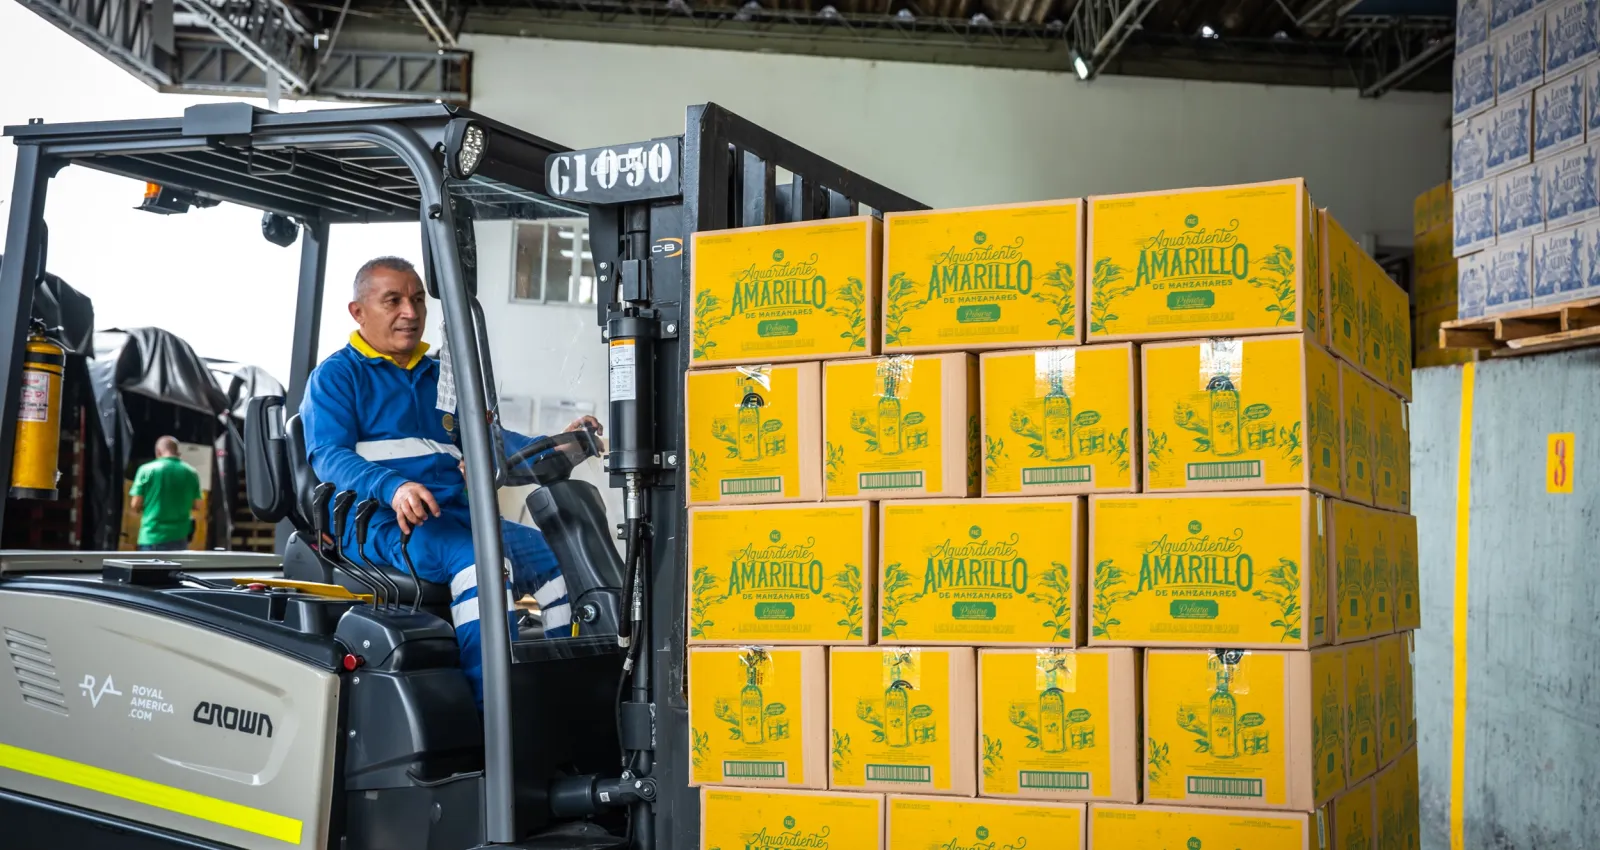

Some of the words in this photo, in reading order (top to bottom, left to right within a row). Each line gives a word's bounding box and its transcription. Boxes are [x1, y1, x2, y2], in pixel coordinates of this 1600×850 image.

[935, 236, 1024, 270] Aguardiente
[1144, 218, 1240, 255] Aguardiente
[738, 253, 819, 286] Aguardiente
[927, 260, 1033, 301] AMARILLO
[1135, 243, 1249, 287] AMARILLO
[730, 276, 827, 317] AMARILLO
[958, 294, 1018, 303] MANZANARES
[1168, 279, 1233, 289] MANZANARES
[758, 309, 813, 318] MANZANARES
[1554, 439, 1566, 487] 3
[735, 536, 815, 567] Aguardiente
[930, 532, 1020, 565] Aguardiente
[1145, 527, 1244, 562] Aguardiente
[728, 560, 823, 596] AMARILLO
[923, 558, 1028, 595] AMARILLO
[1137, 553, 1254, 592] AMARILLO
[130, 698, 174, 714] AMERICA
[132, 685, 164, 700] ROYAL
[128, 711, 152, 721] .COM
[193, 701, 273, 738] CROWN
[749, 825, 828, 850] Aguardiente
